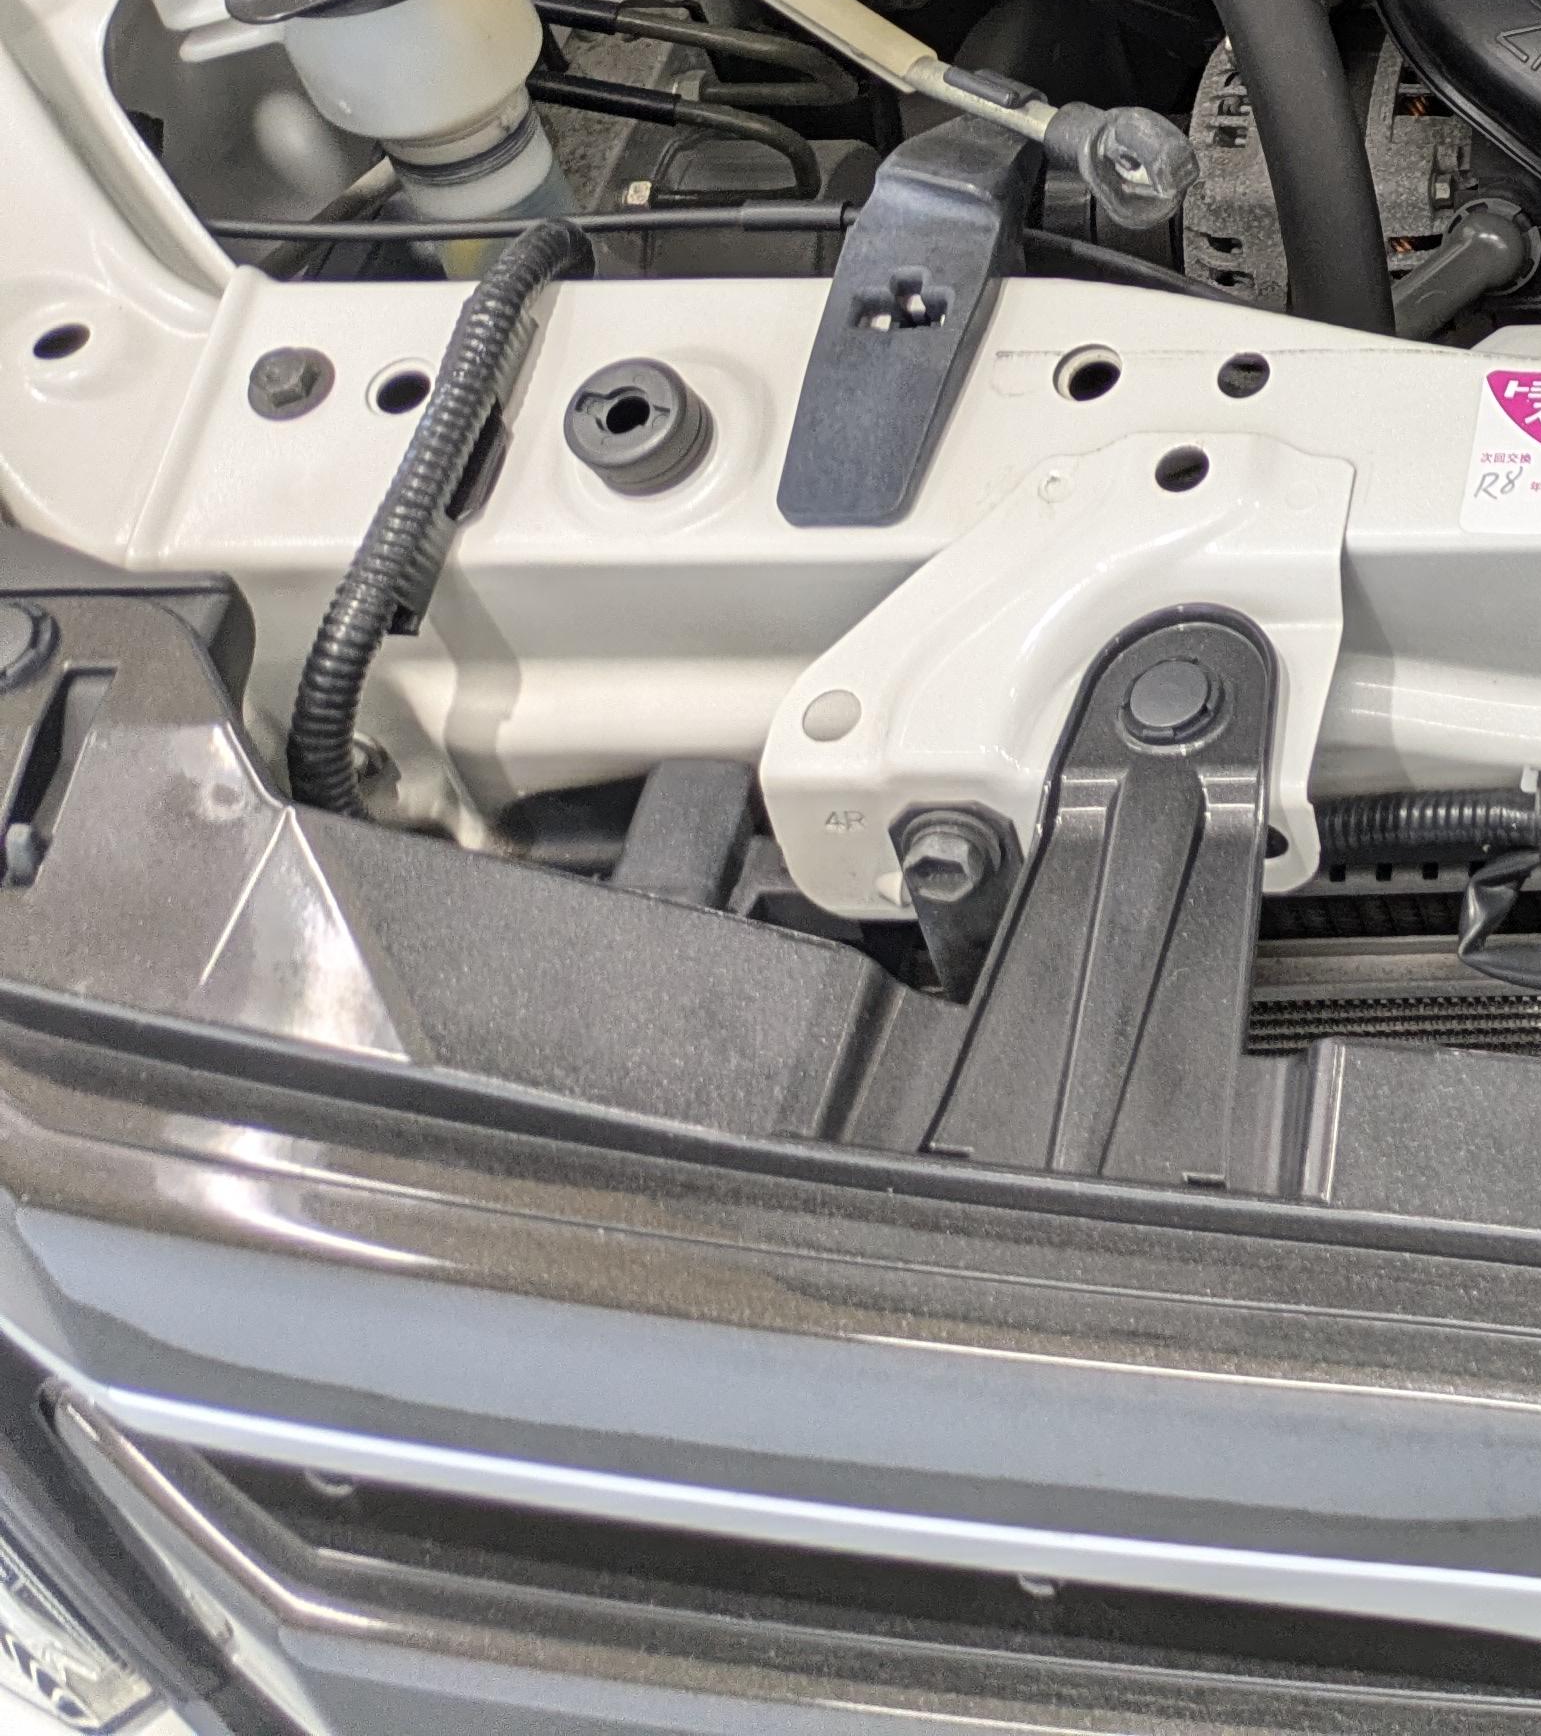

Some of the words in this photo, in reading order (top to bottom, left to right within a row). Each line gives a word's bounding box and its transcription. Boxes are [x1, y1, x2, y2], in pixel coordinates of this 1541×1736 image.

[1480, 452, 1532, 464] 次回交換
[1473, 466, 1523, 501] R8
[1530, 480, 1541, 492] 年
[824, 809, 866, 831] 4R
